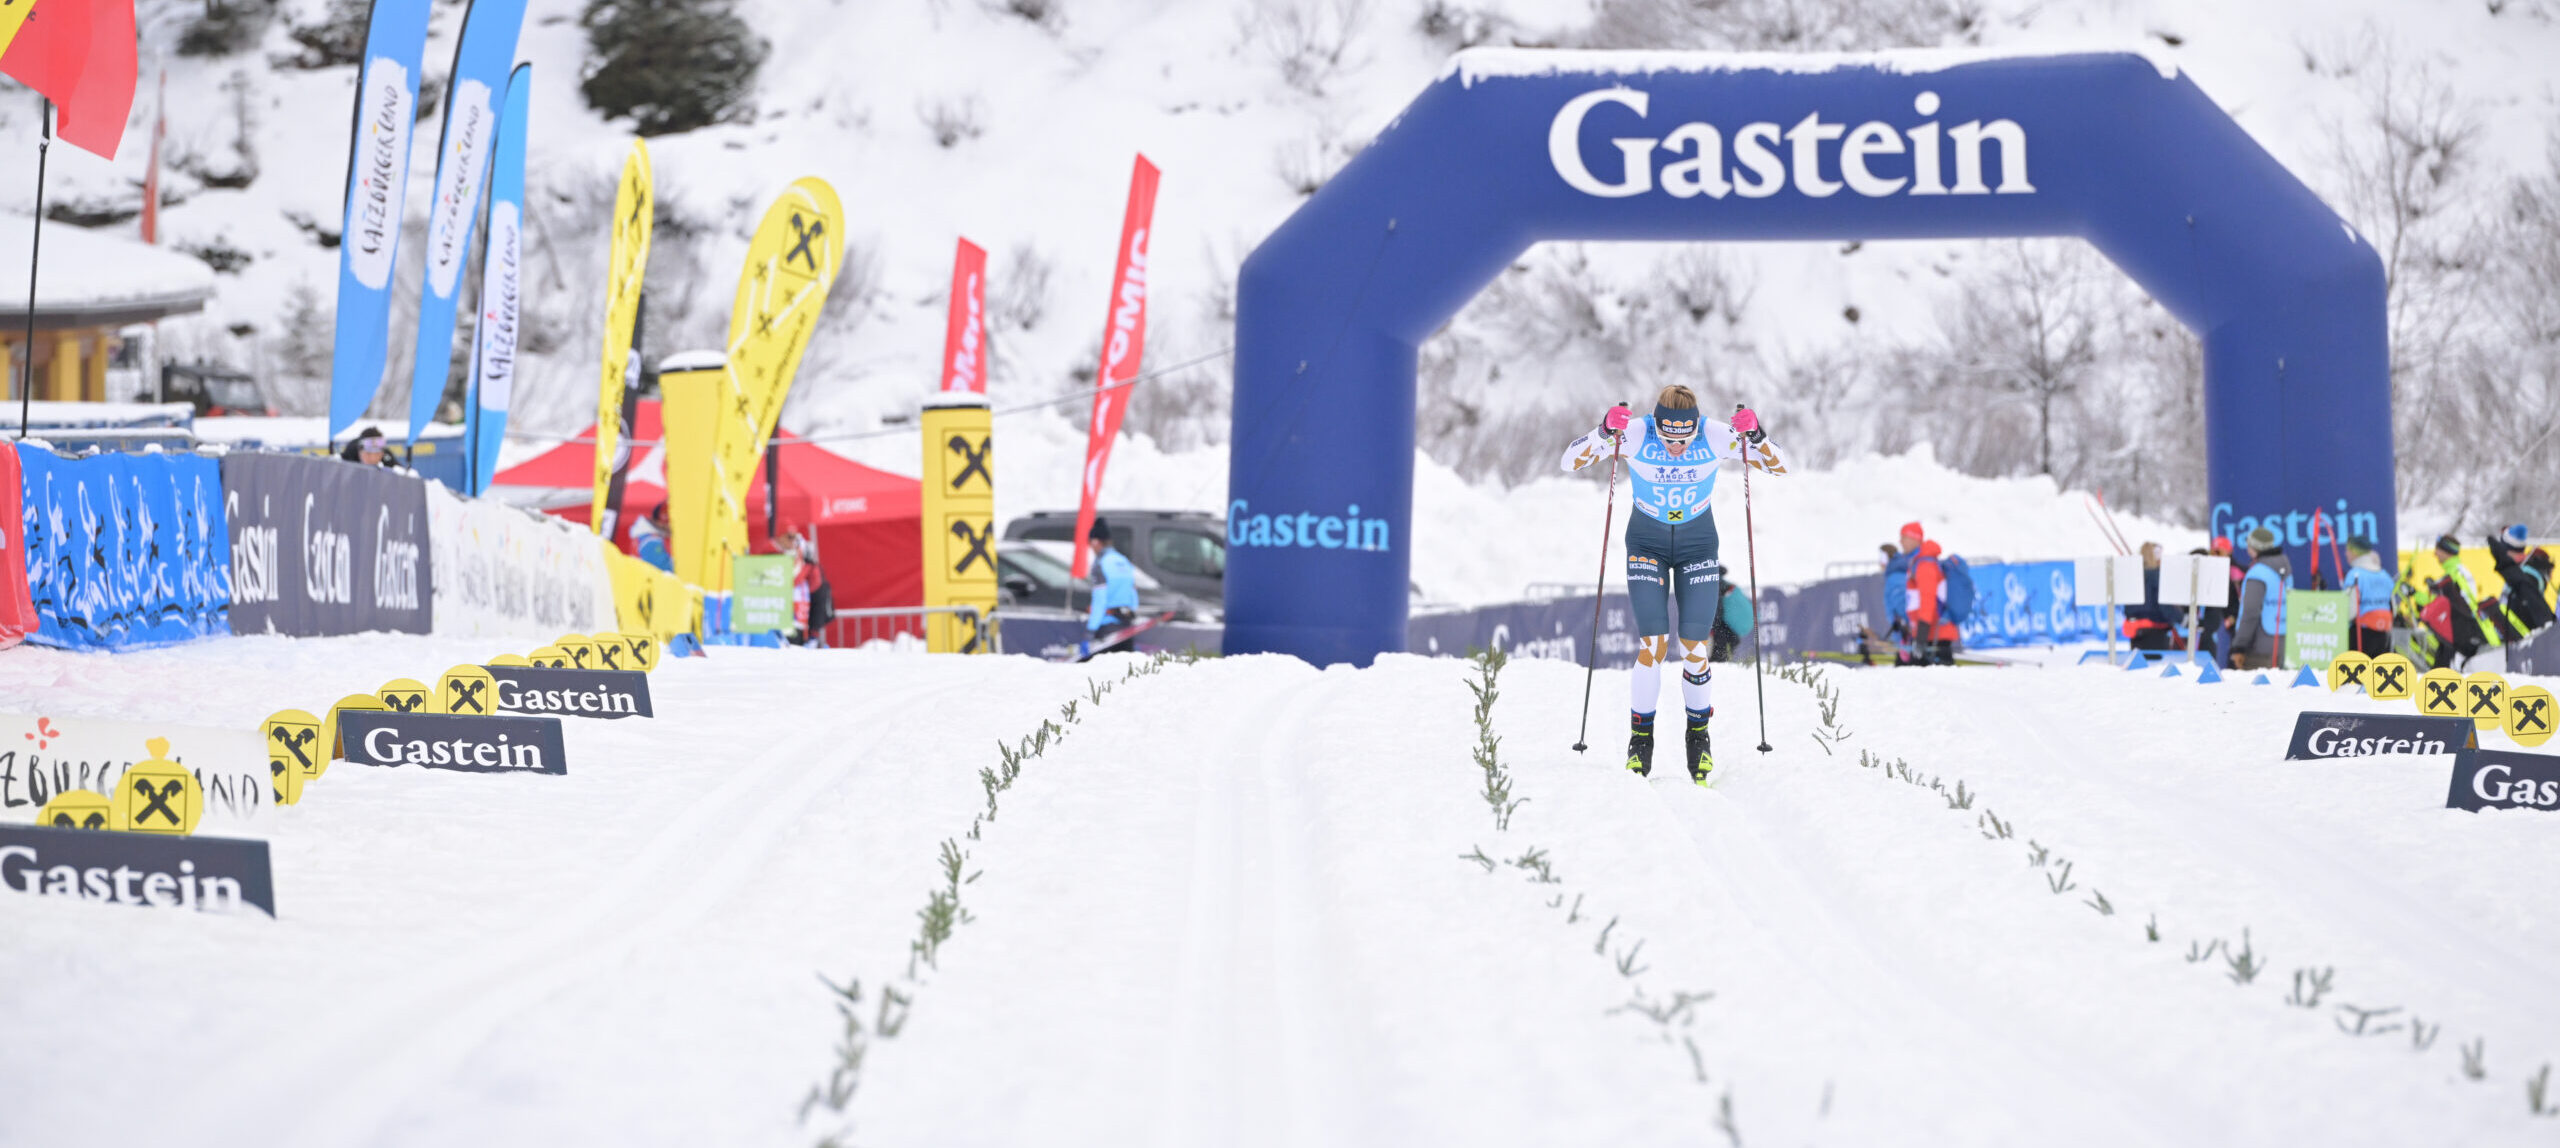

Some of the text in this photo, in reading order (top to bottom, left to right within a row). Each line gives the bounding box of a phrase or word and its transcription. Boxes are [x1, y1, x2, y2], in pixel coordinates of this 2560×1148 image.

[1548, 88, 2036, 200] Gastein
[1642, 442, 1711, 461] Gasein
[1652, 485, 1698, 508] 566
[1227, 498, 1390, 551] Gastein
[2211, 498, 2378, 547] Gastein
[496, 679, 638, 713] Gastein
[364, 727, 544, 769] Gastein
[2308, 727, 2445, 757] Gastein
[0, 845, 243, 911] Gastein
